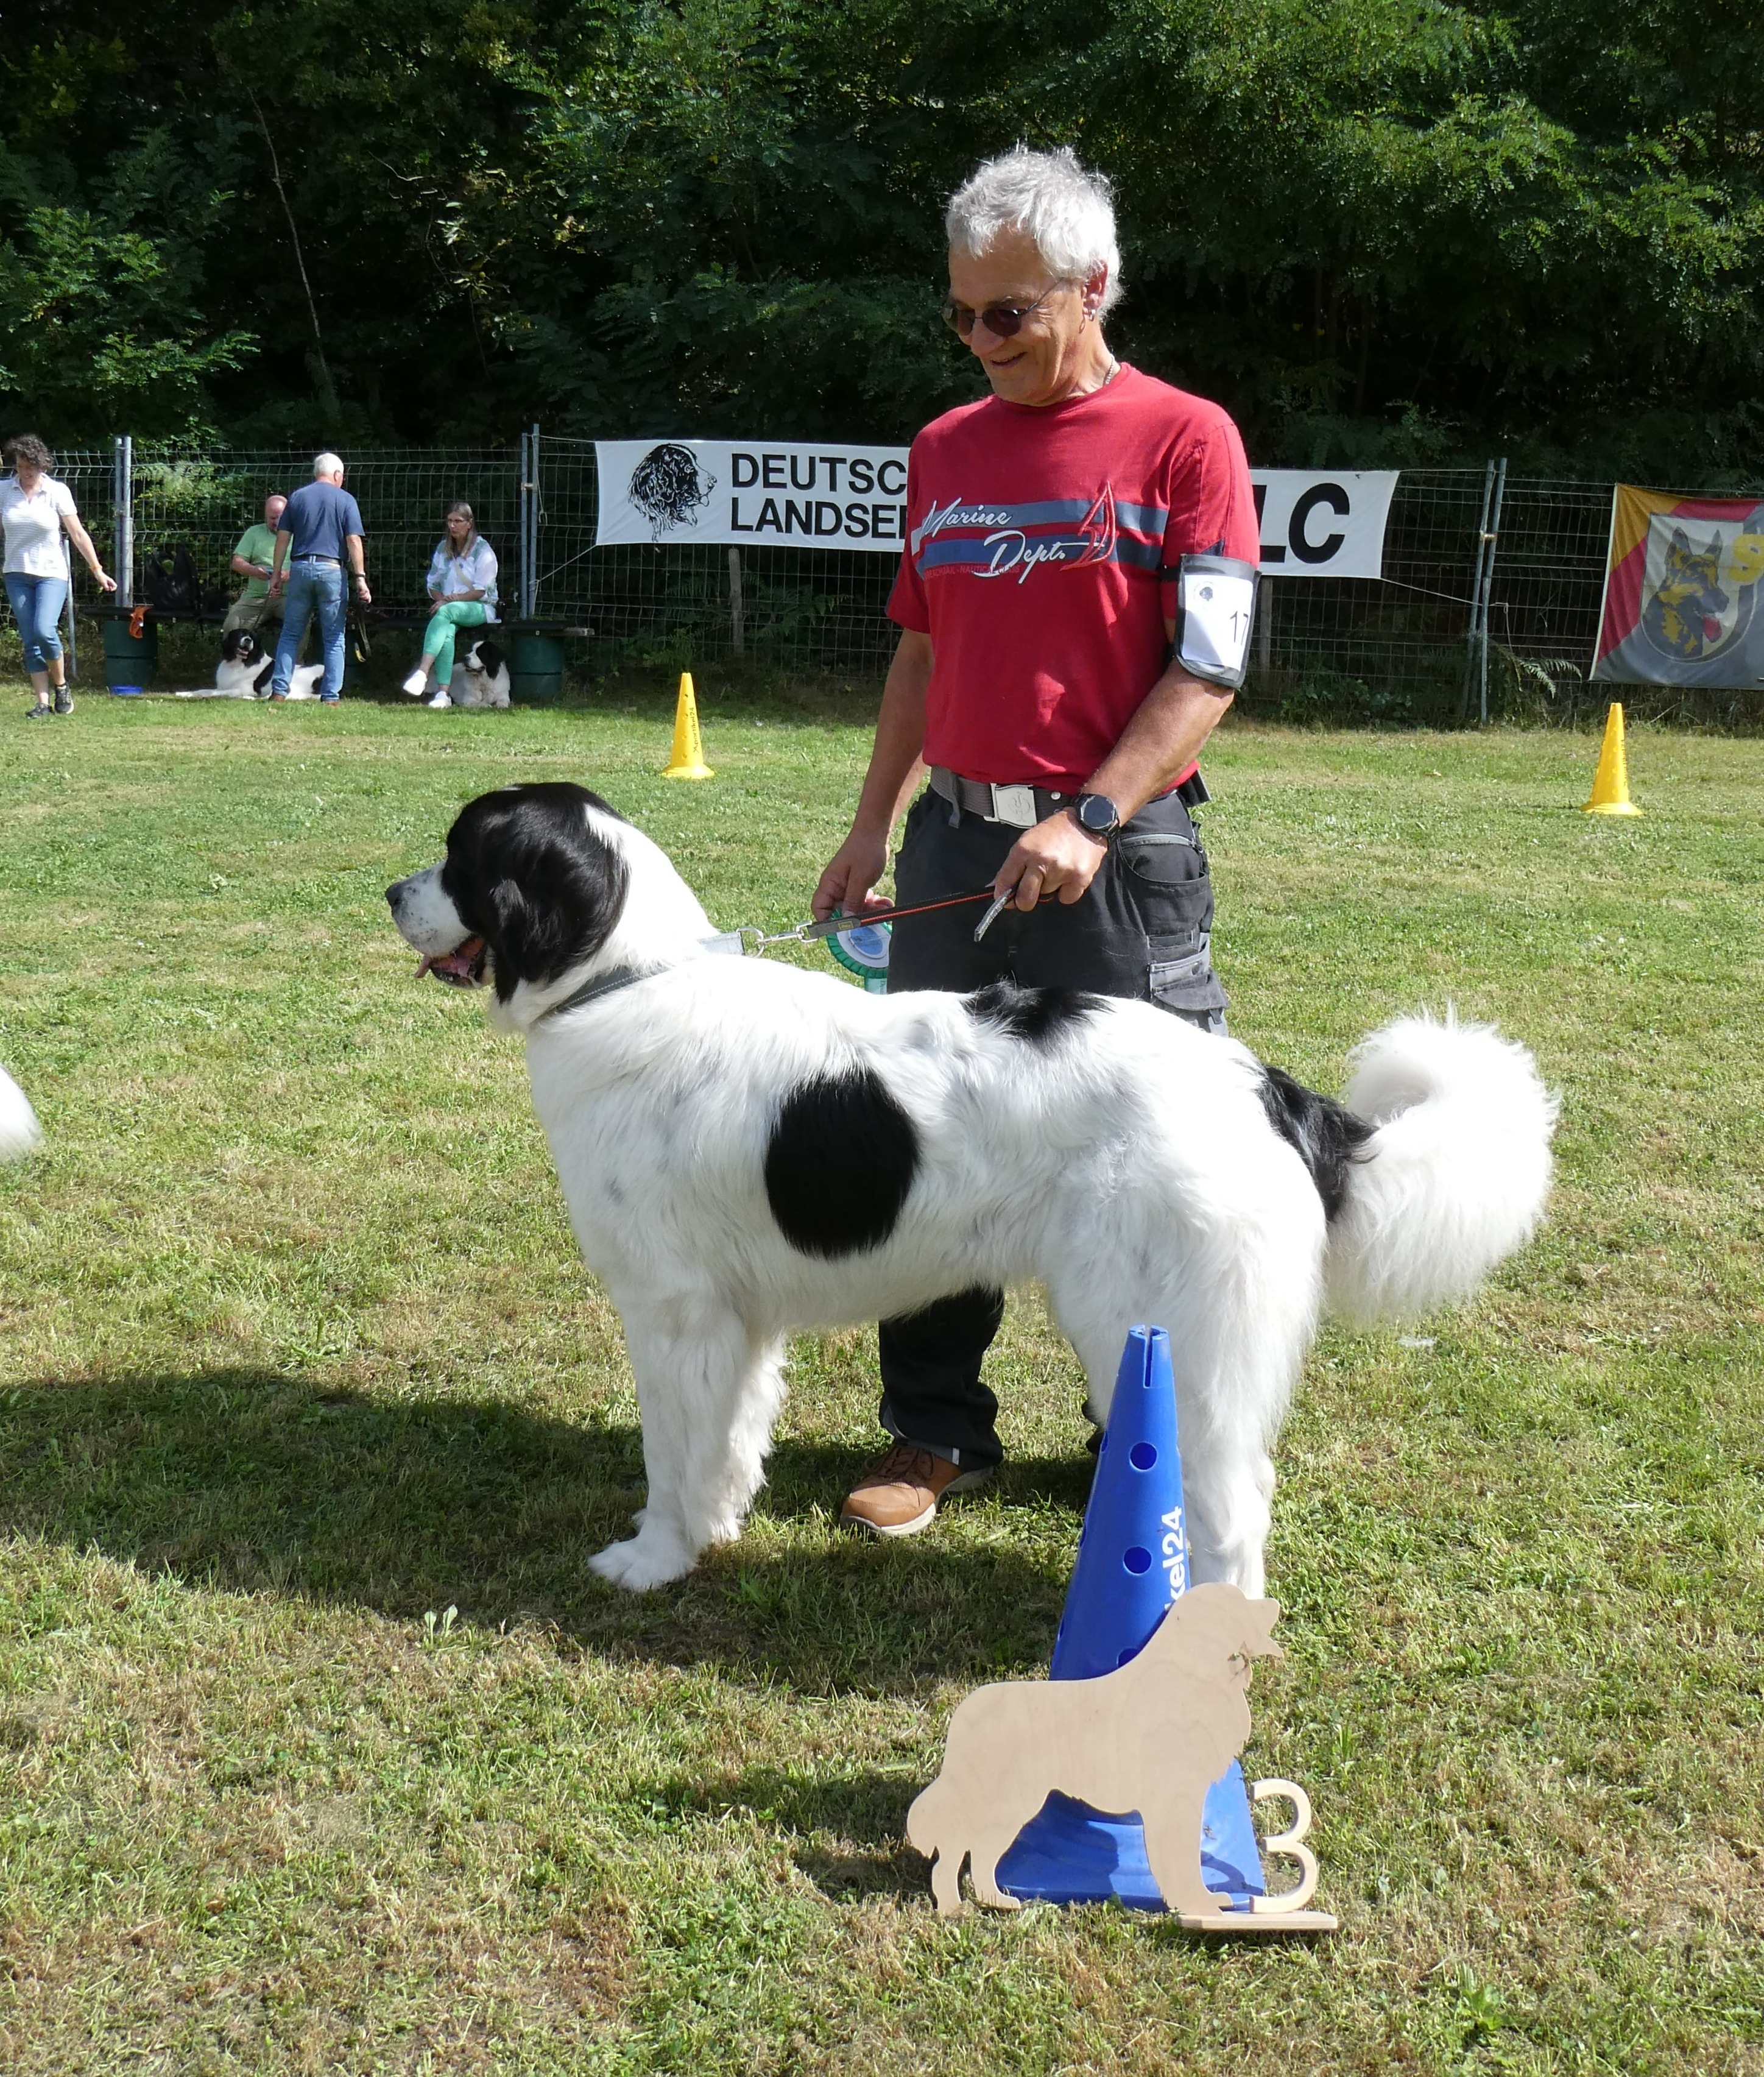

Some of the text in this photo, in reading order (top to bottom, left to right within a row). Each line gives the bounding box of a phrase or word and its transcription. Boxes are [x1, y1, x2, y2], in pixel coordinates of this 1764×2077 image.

[732, 453, 908, 495] DEUTSC
[920, 497, 1012, 538] Marine
[983, 529, 1105, 584] Dept.
[1251, 1778, 1318, 1914] 3
